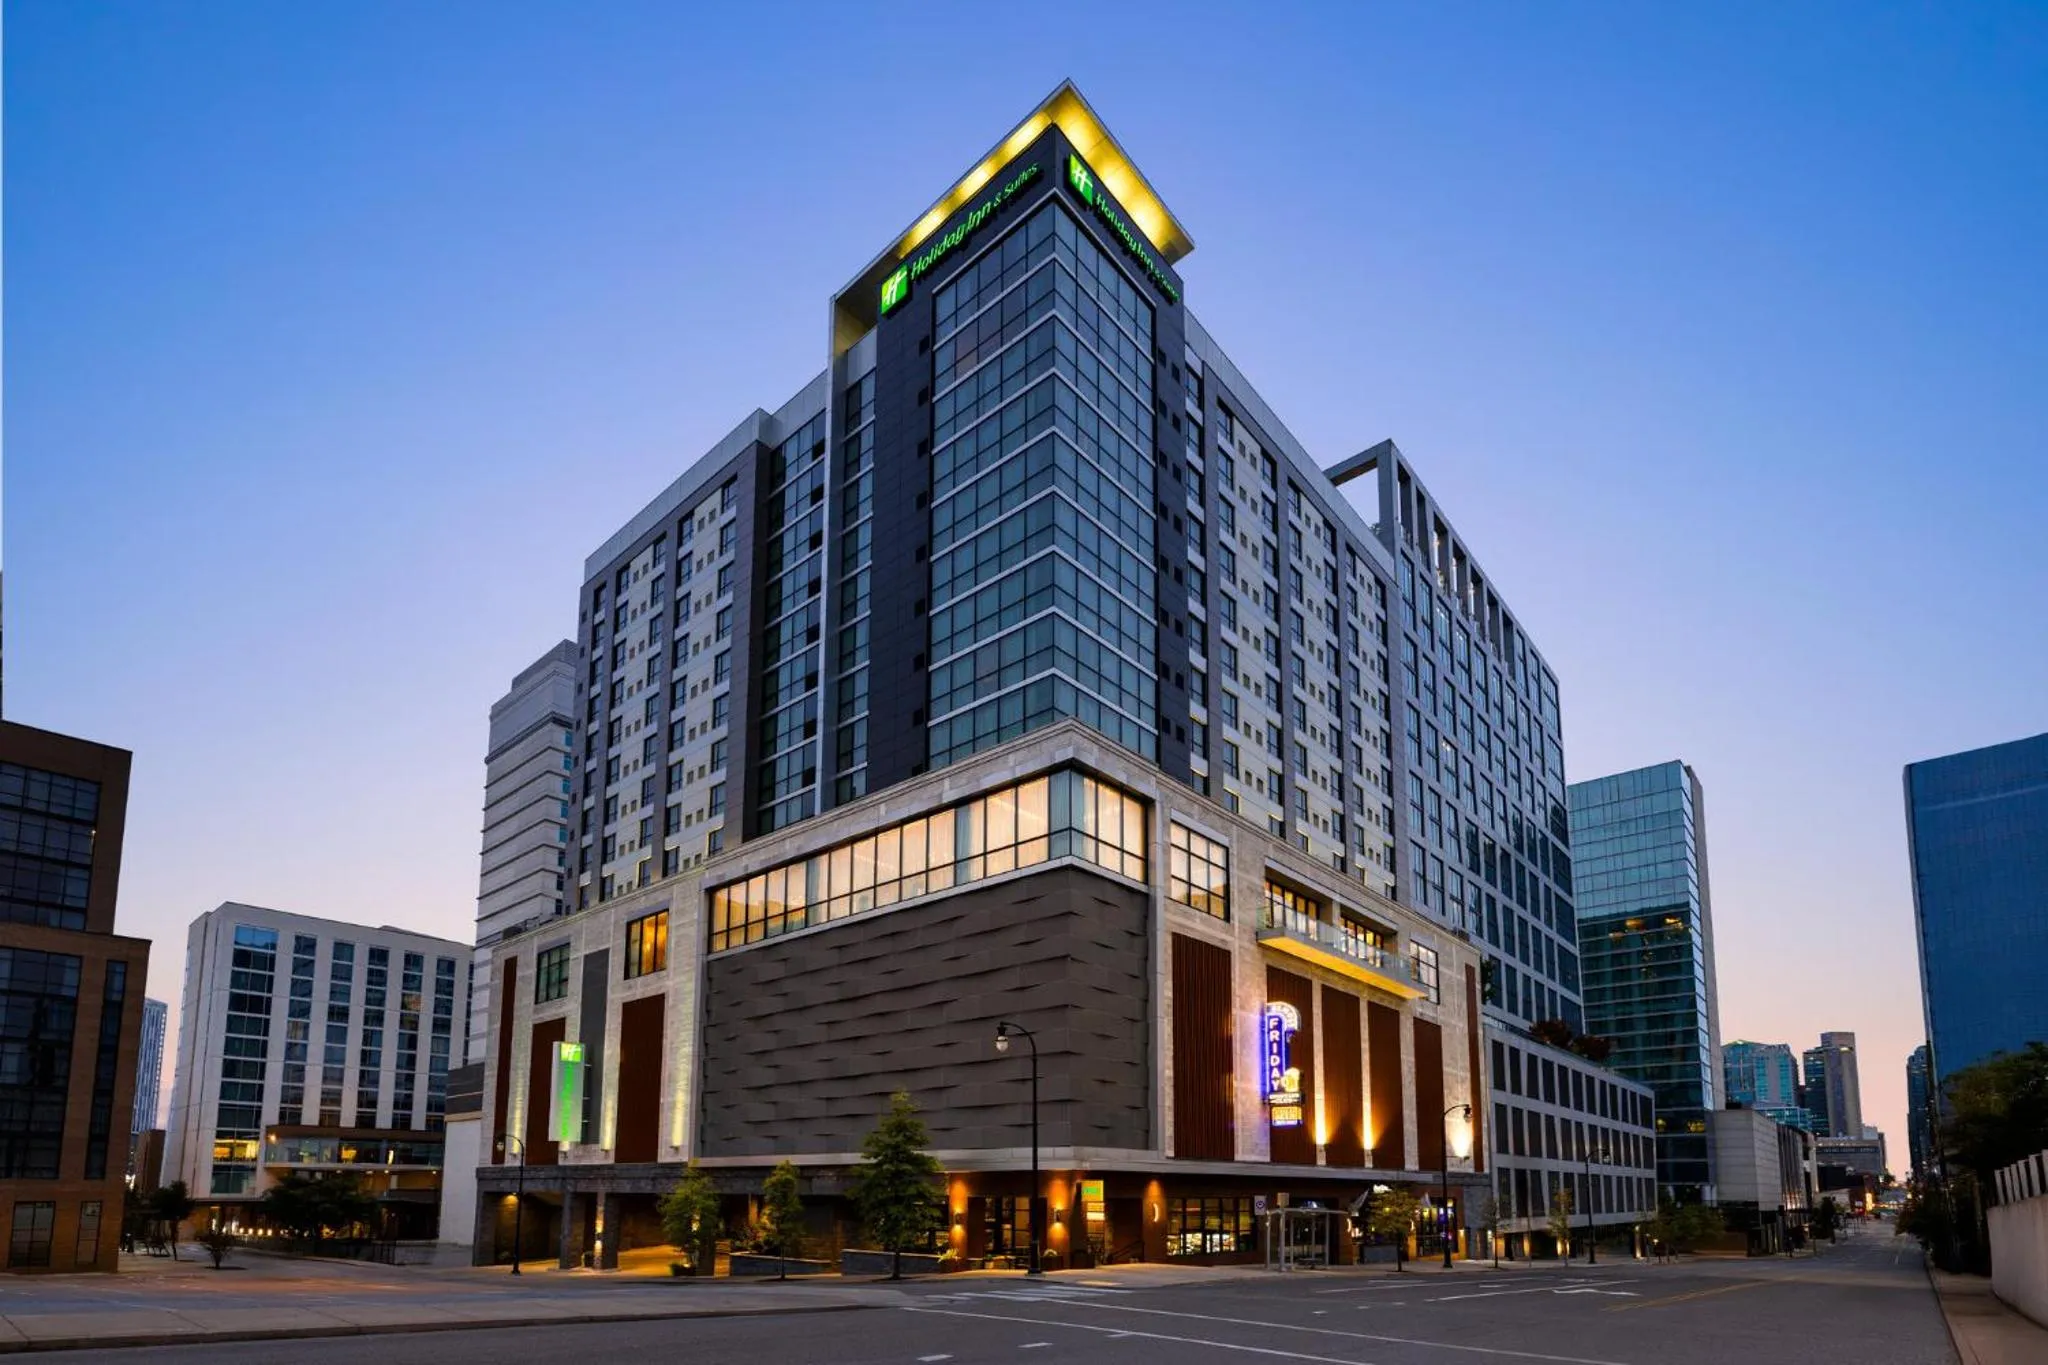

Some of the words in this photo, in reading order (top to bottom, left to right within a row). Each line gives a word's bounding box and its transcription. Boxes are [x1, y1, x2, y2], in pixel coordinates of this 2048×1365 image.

[911, 222, 967, 280] Holiday
[966, 201, 991, 234] Inn
[993, 192, 1002, 207] &
[1096, 193, 1138, 252] Holiday
[1269, 1017, 1281, 1091] FRIDAY
